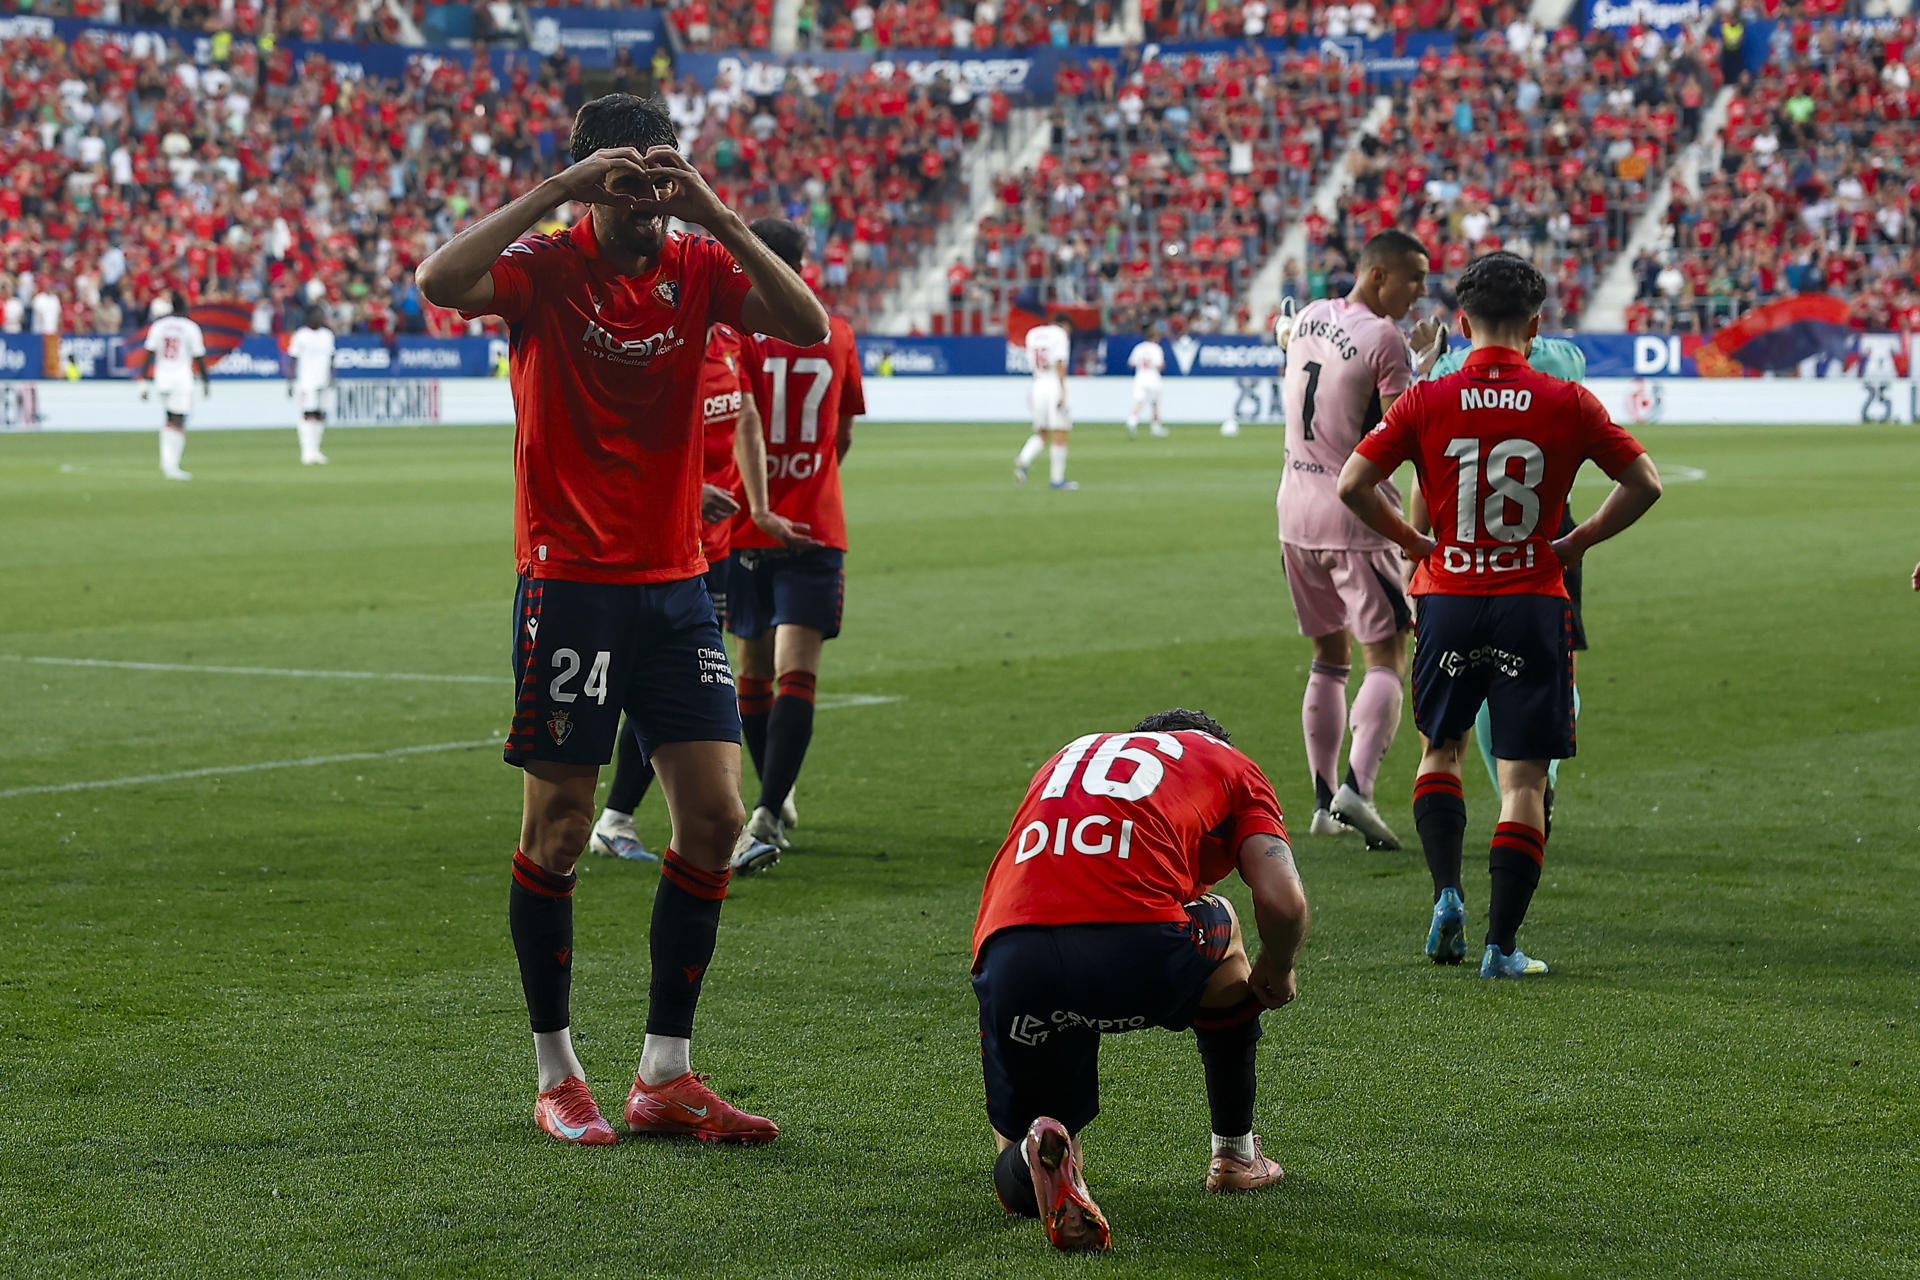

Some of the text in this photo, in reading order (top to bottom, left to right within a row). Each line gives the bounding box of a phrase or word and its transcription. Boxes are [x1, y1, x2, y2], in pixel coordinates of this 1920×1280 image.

[762, 356, 834, 444] 17
[1302, 360, 1322, 441] 1
[1460, 387, 1532, 412] MORO
[1443, 437, 1545, 543] 18
[1443, 543, 1534, 573] DIGI
[550, 647, 611, 705] 24
[700, 671, 714, 683] de
[1039, 732, 1184, 802] 16
[1014, 814, 1134, 865] DIGI
[1050, 1010, 1146, 1031] CRYPTO
